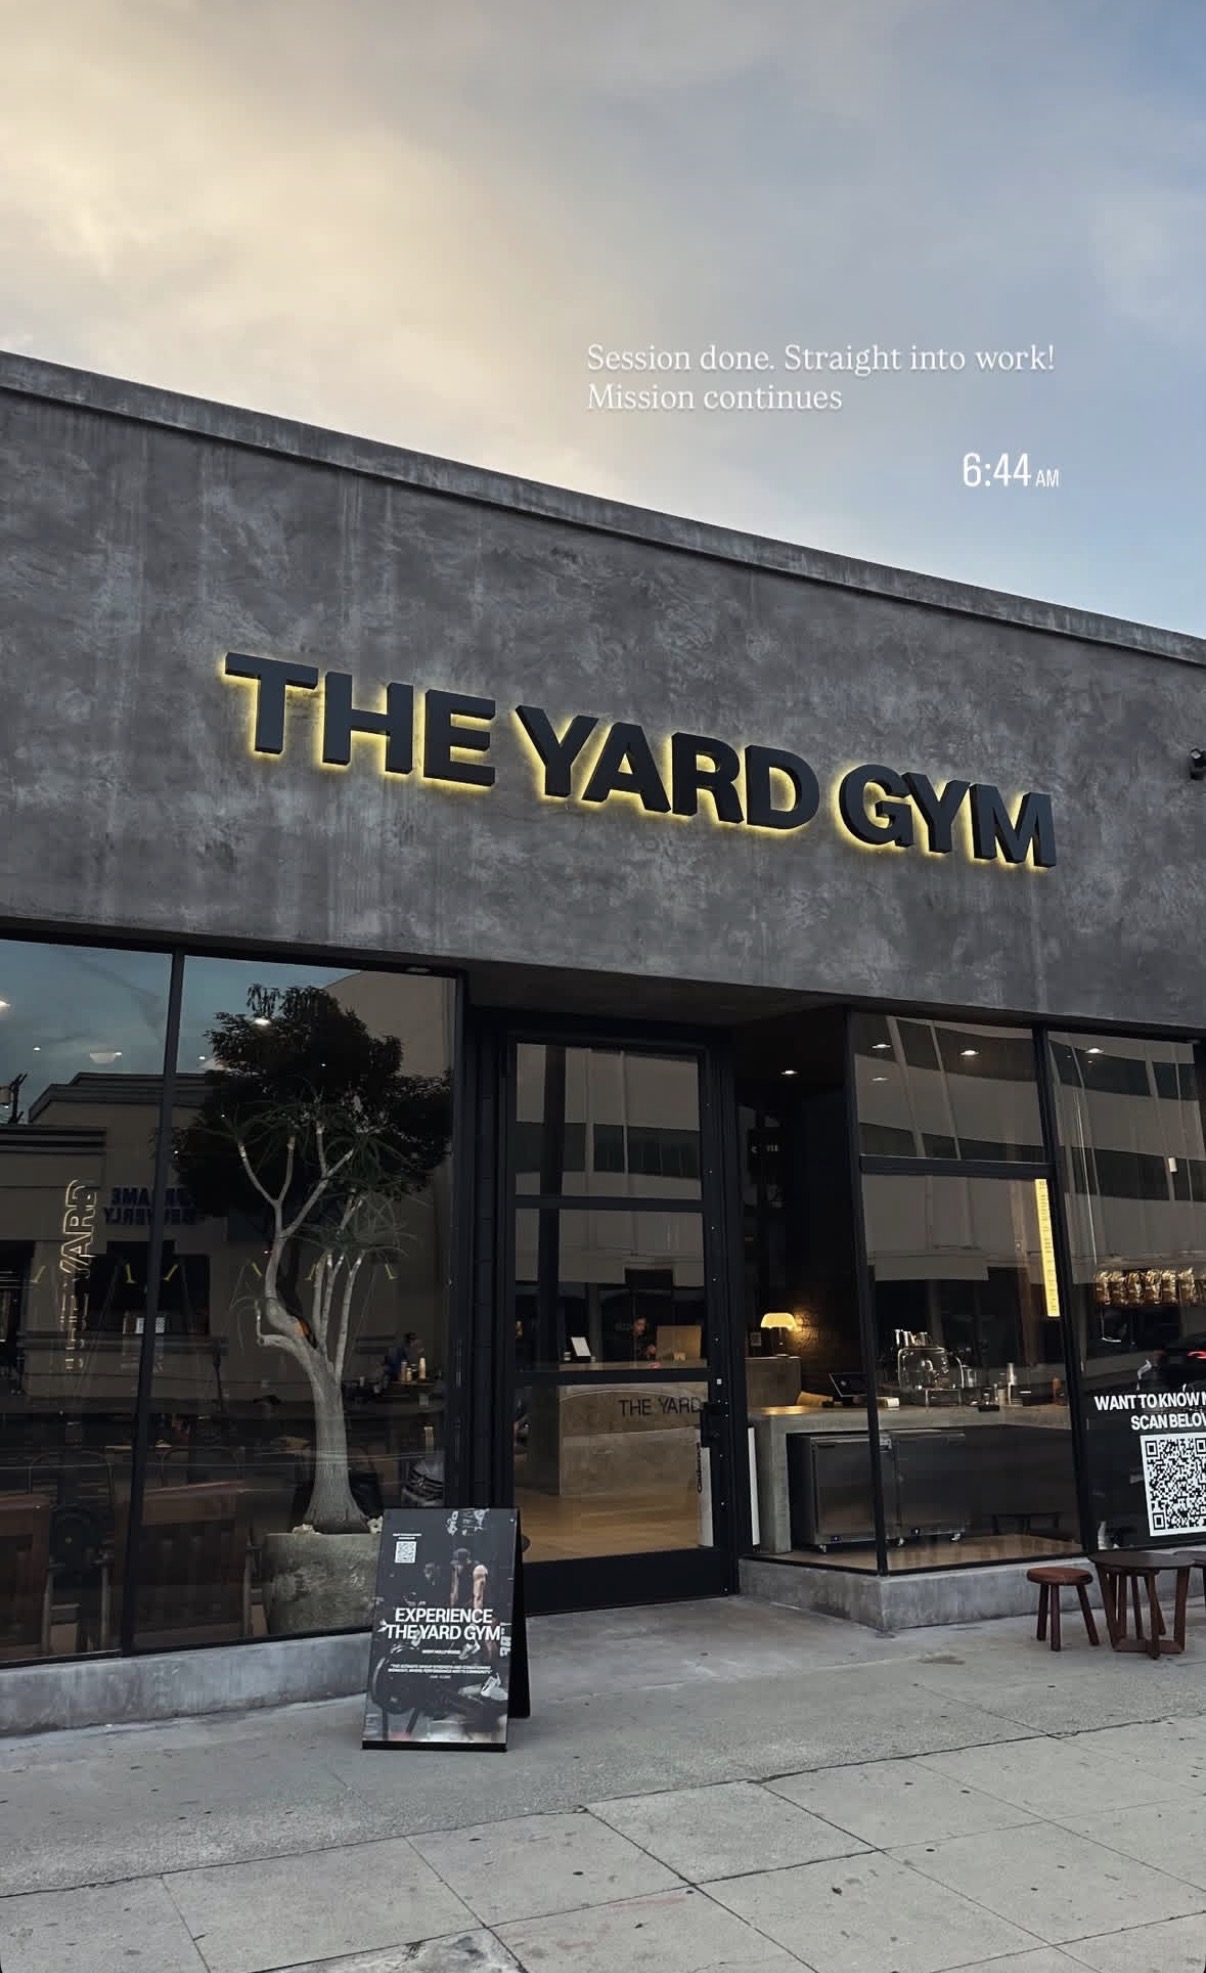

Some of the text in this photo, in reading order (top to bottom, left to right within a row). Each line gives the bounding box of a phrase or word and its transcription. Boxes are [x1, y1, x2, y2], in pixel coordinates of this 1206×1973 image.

[225, 652, 1056, 869] THE YARD GYM
[618, 1399, 651, 1417] THE
[1094, 1394, 1136, 1411] WANT
[1137, 1393, 1158, 1409] TO
[1158, 1391, 1200, 1408] KNOW
[1130, 1413, 1168, 1431] SCAN
[395, 1607, 493, 1624] EXPERIENCE
[386, 1624, 501, 1641] THE YARD GYM
